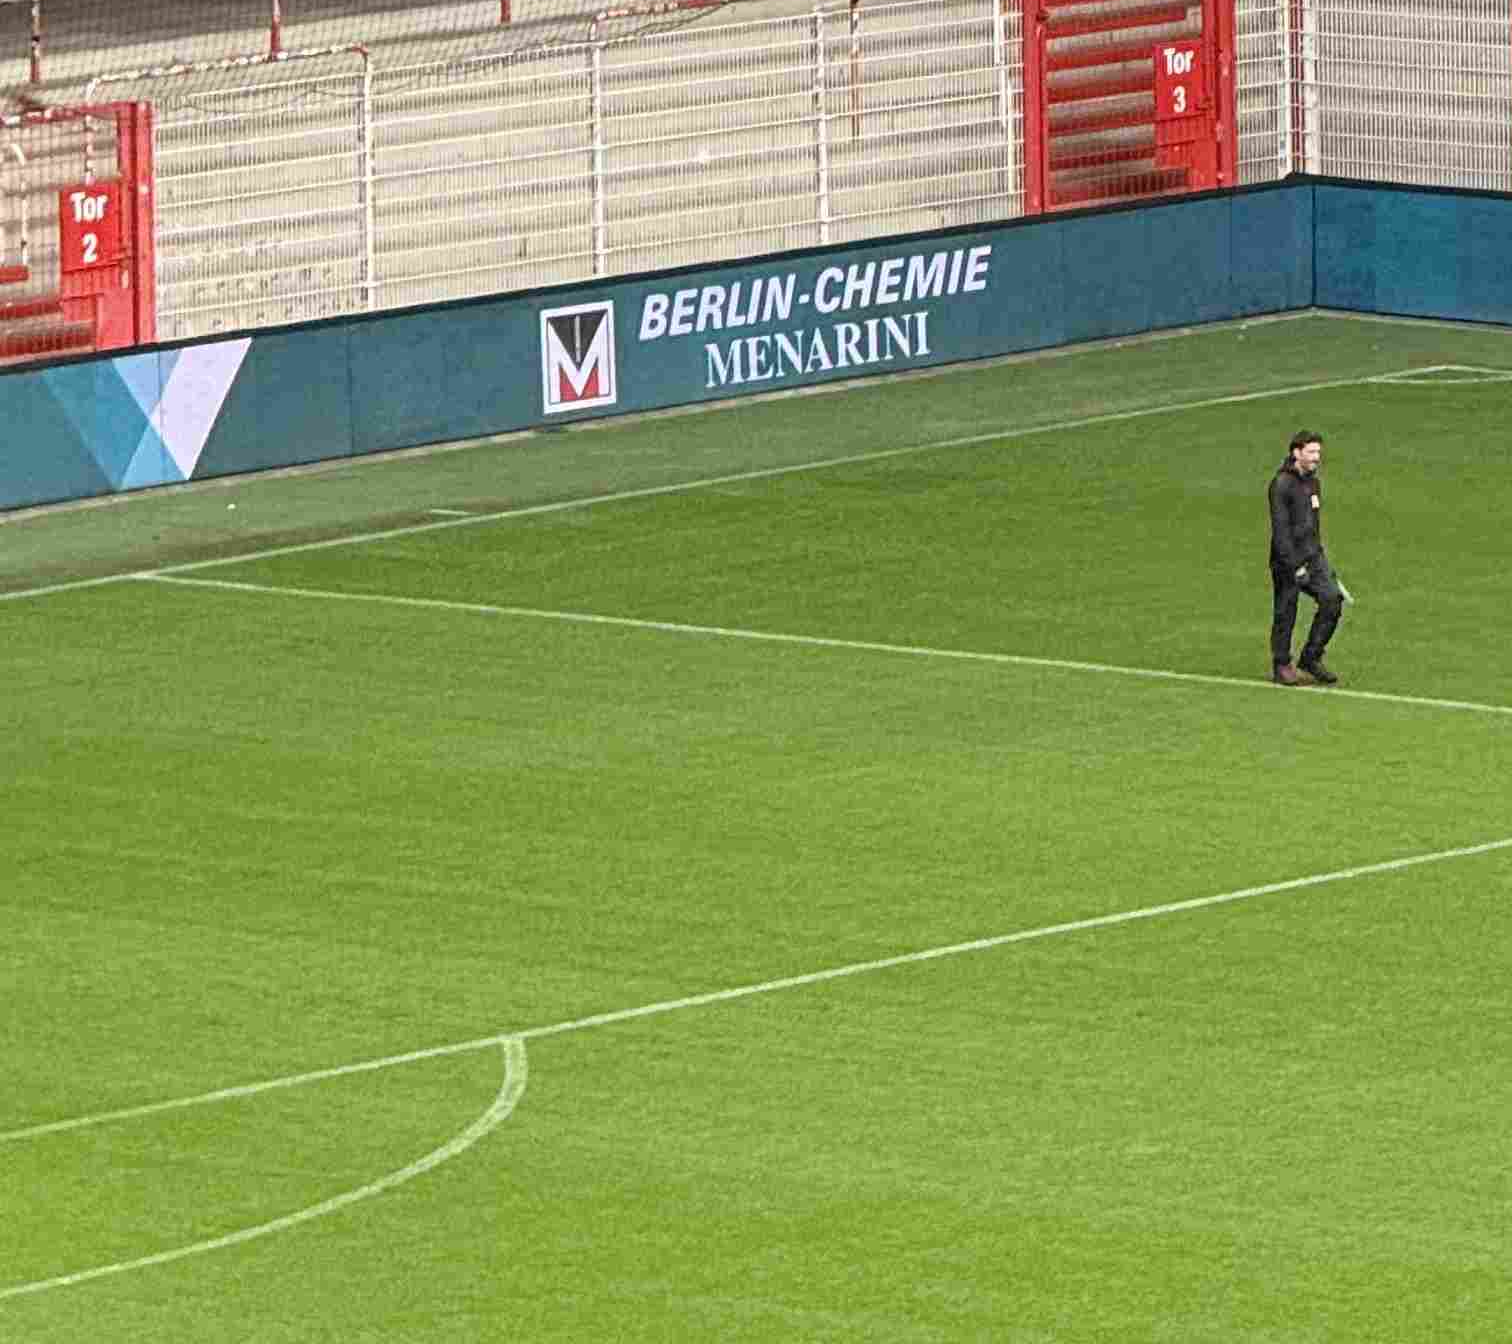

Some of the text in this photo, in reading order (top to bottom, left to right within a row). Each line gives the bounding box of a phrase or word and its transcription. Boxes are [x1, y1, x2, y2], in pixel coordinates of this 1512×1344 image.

[1164, 46, 1194, 75] Tor
[1172, 87, 1188, 114] 3
[69, 192, 108, 222] Tor
[82, 234, 98, 264] 2
[640, 245, 991, 341] BERLIN-CHEMIE
[705, 312, 930, 388] MENARINI
